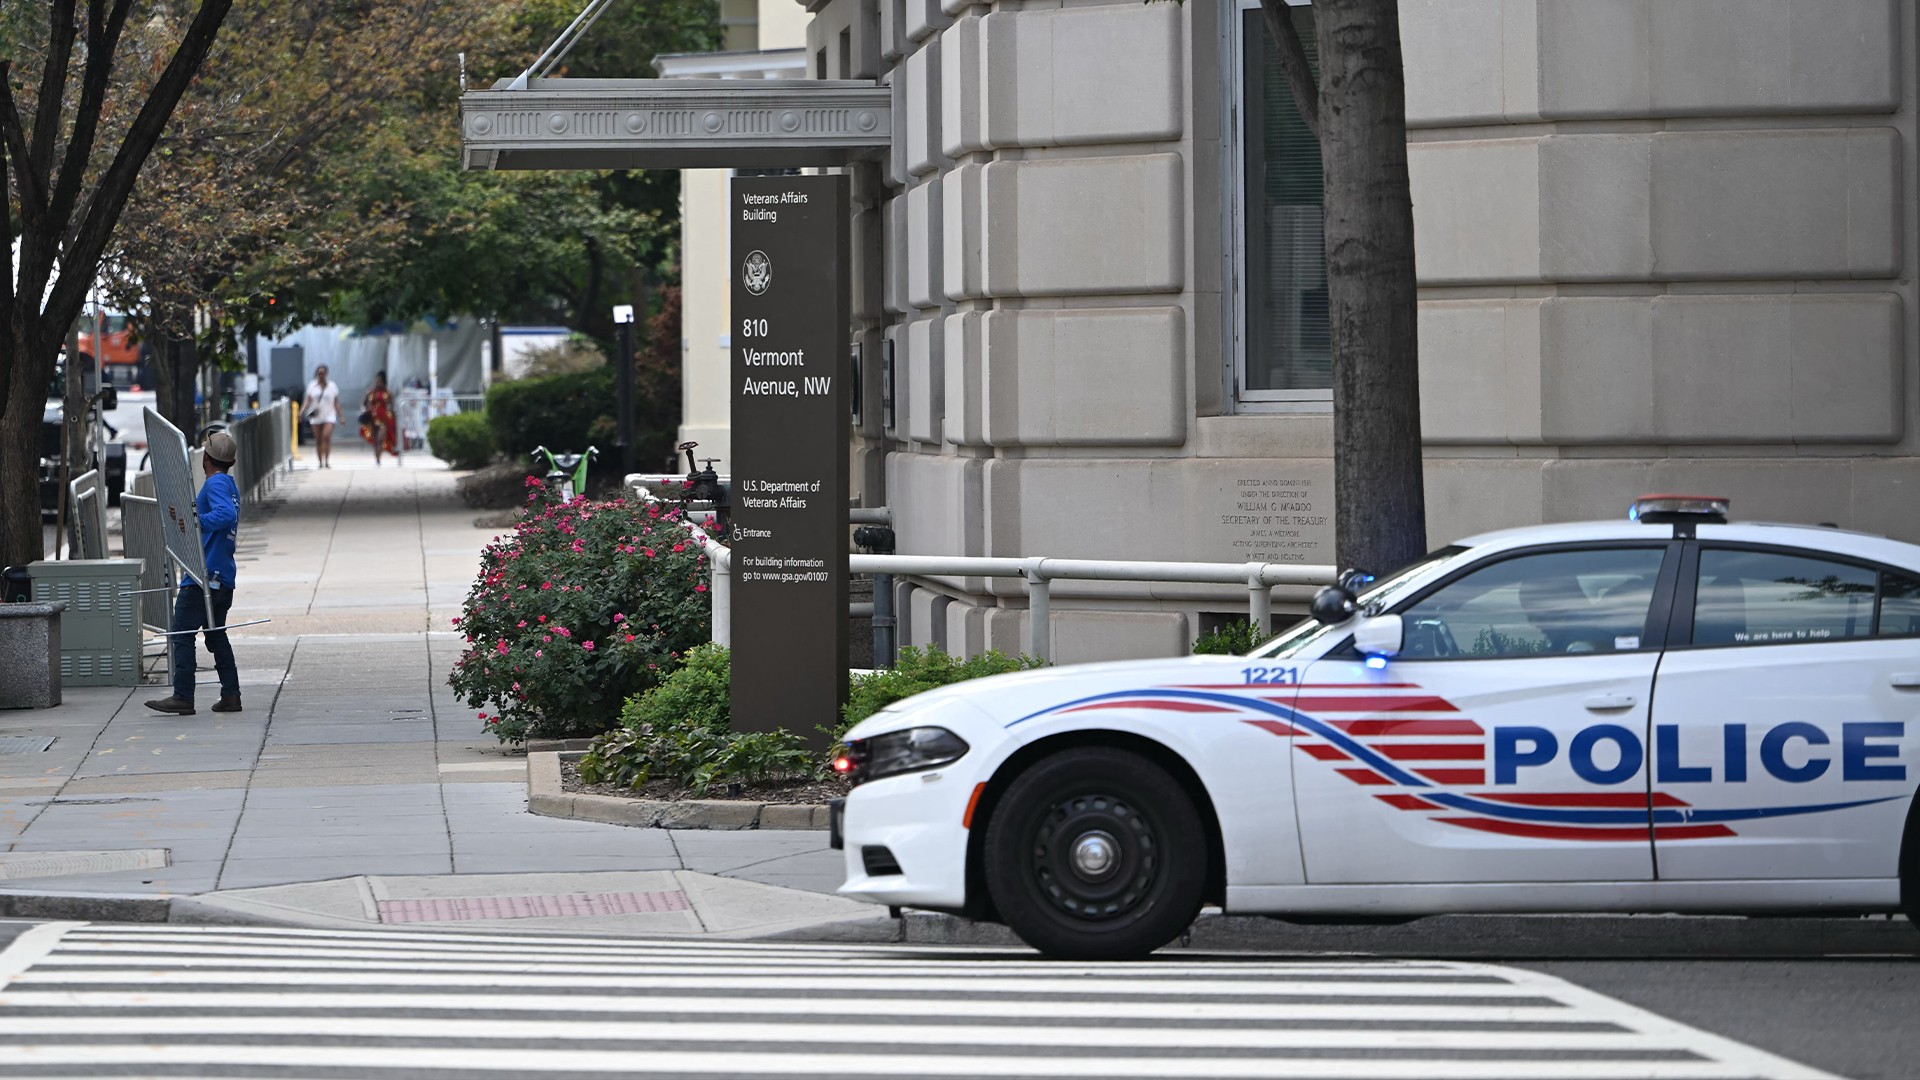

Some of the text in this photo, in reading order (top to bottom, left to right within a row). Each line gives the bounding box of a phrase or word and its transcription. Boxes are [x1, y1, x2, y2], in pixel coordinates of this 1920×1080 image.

[743, 192, 808, 204] Veterans Affairs
[743, 209, 777, 222] Building
[743, 319, 768, 337] 810
[743, 349, 804, 366] Vermont
[743, 377, 831, 398] Avenue, NW
[743, 480, 820, 494] U.S. Department of
[743, 497, 806, 509] Veterans Affairs
[1237, 502, 1267, 511] WILLIAM
[1222, 515, 1328, 525] SECRETARY OF THE TREASURY
[744, 528, 771, 538] Entrance
[743, 557, 824, 569] For building information
[743, 572, 829, 583] go to www.gsa.gov/01007
[1735, 632, 1749, 641] We
[1810, 629, 1830, 638] help
[1241, 667, 1297, 685] 1221
[1494, 721, 1906, 784] POLICE
